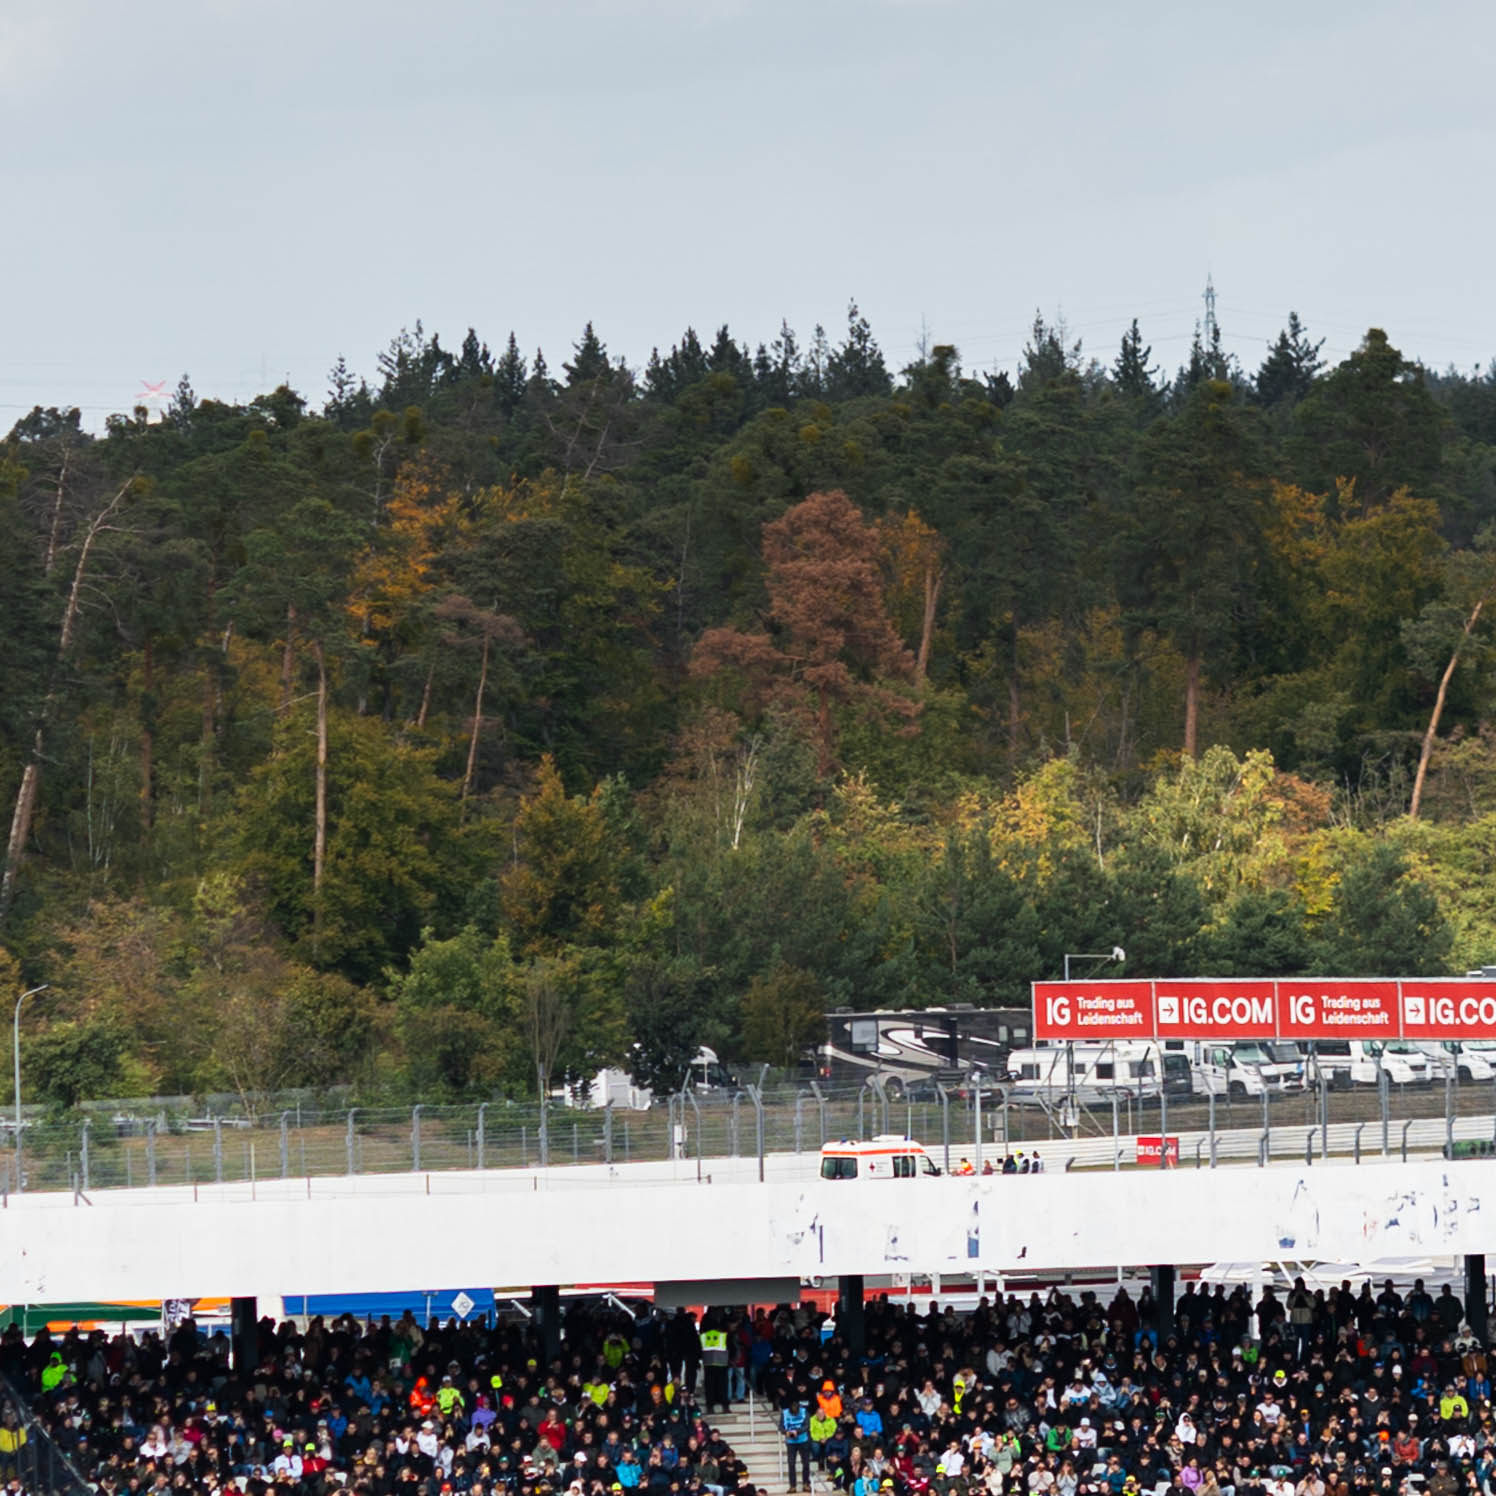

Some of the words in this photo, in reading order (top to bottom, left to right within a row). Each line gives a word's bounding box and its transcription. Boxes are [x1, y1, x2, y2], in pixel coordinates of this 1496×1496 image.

[1077, 996, 1115, 1010] Trading
[1117, 999, 1134, 1008] aus
[1290, 996, 1315, 1024] IG
[1322, 996, 1360, 1010] Trading
[1363, 999, 1380, 1008] aus
[1047, 997, 1070, 1025] IG
[1078, 1010, 1142, 1025] Leidenschaft
[1183, 997, 1272, 1025] IG.COM
[1322, 1010, 1388, 1024] Leidenschaft
